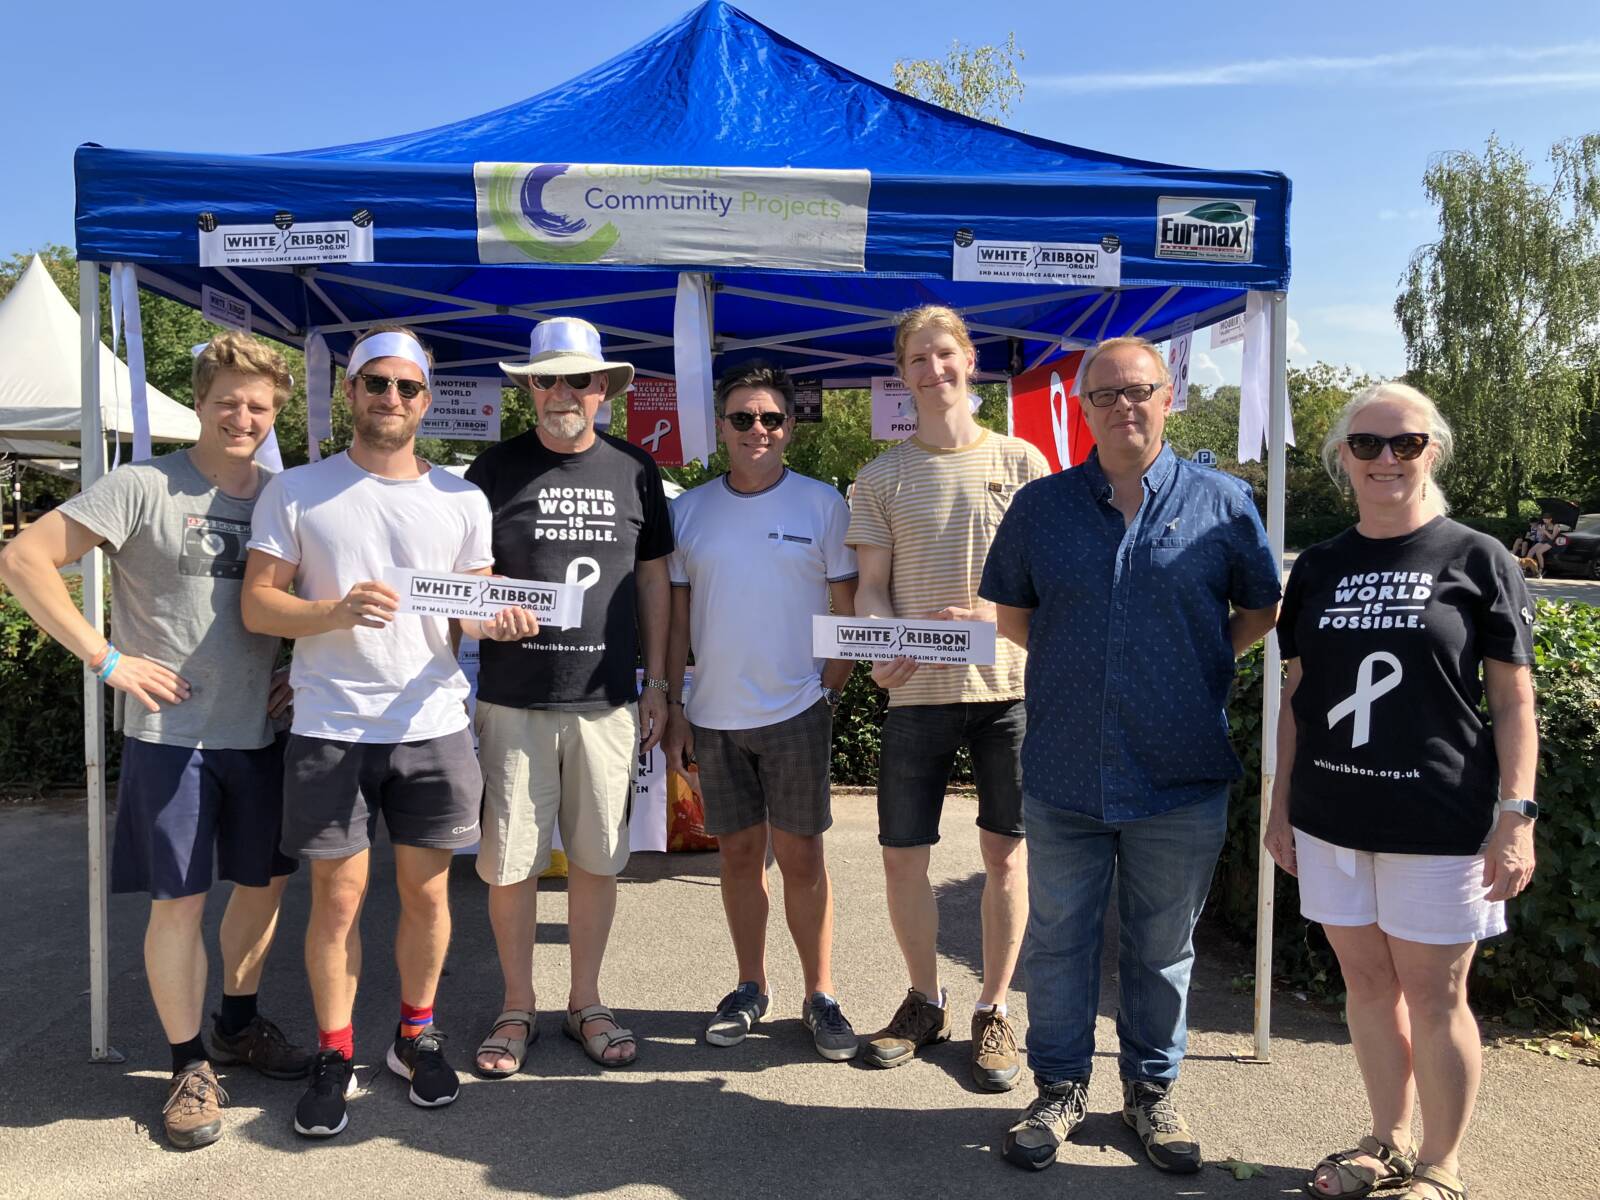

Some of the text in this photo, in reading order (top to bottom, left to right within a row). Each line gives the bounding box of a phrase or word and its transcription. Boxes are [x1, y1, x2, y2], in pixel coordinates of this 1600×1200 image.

[584, 187, 841, 220] Community Projects
[1161, 217, 1243, 248] Eurmax
[227, 234, 346, 248] WHITE RIBBON
[980, 249, 1095, 264] WHITE RIBBON
[434, 380, 478, 388] ANOTHER
[440, 389, 472, 397] WORLD
[433, 407, 477, 416] POSSIBLE
[538, 488, 615, 501] ANOTHER
[538, 500, 616, 516] WORLD
[568, 516, 584, 528] IS
[534, 528, 618, 542] POSSIBLE.
[1336, 572, 1433, 588] ANOTHER
[415, 581, 553, 605] WHITE RIBBON
[1335, 585, 1431, 603] WORLD
[429, 606, 449, 614] MALE
[451, 608, 487, 618] VIOLENCE
[1363, 602, 1383, 615] IS
[1319, 615, 1426, 629] POSSIBLE.
[840, 629, 966, 645] WHITE RIBBON
[521, 642, 606, 653] whiteribbon.org.uk
[1314, 759, 1420, 779] whiteribbon.org.uk
